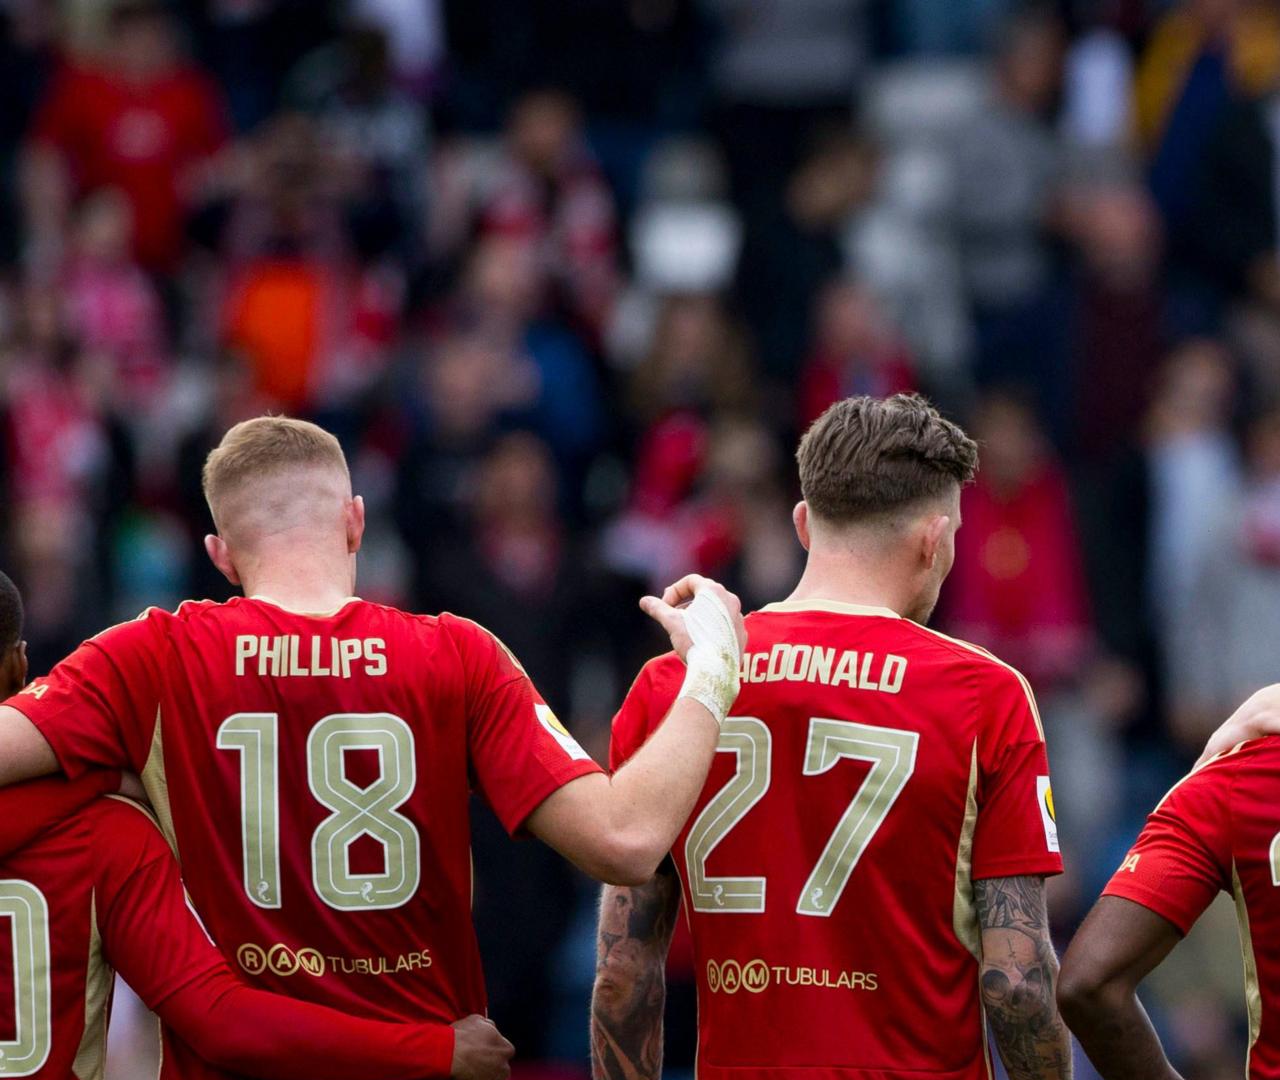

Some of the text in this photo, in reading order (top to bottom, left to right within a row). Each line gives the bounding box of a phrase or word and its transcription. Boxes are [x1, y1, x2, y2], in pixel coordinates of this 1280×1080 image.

[235, 634, 388, 678] PHILLIPS
[216, 712, 421, 912] 18
[685, 716, 919, 917] 27
[238, 943, 433, 977] RAM TUBULARS
[707, 959, 878, 993] RAM TUBULARS
